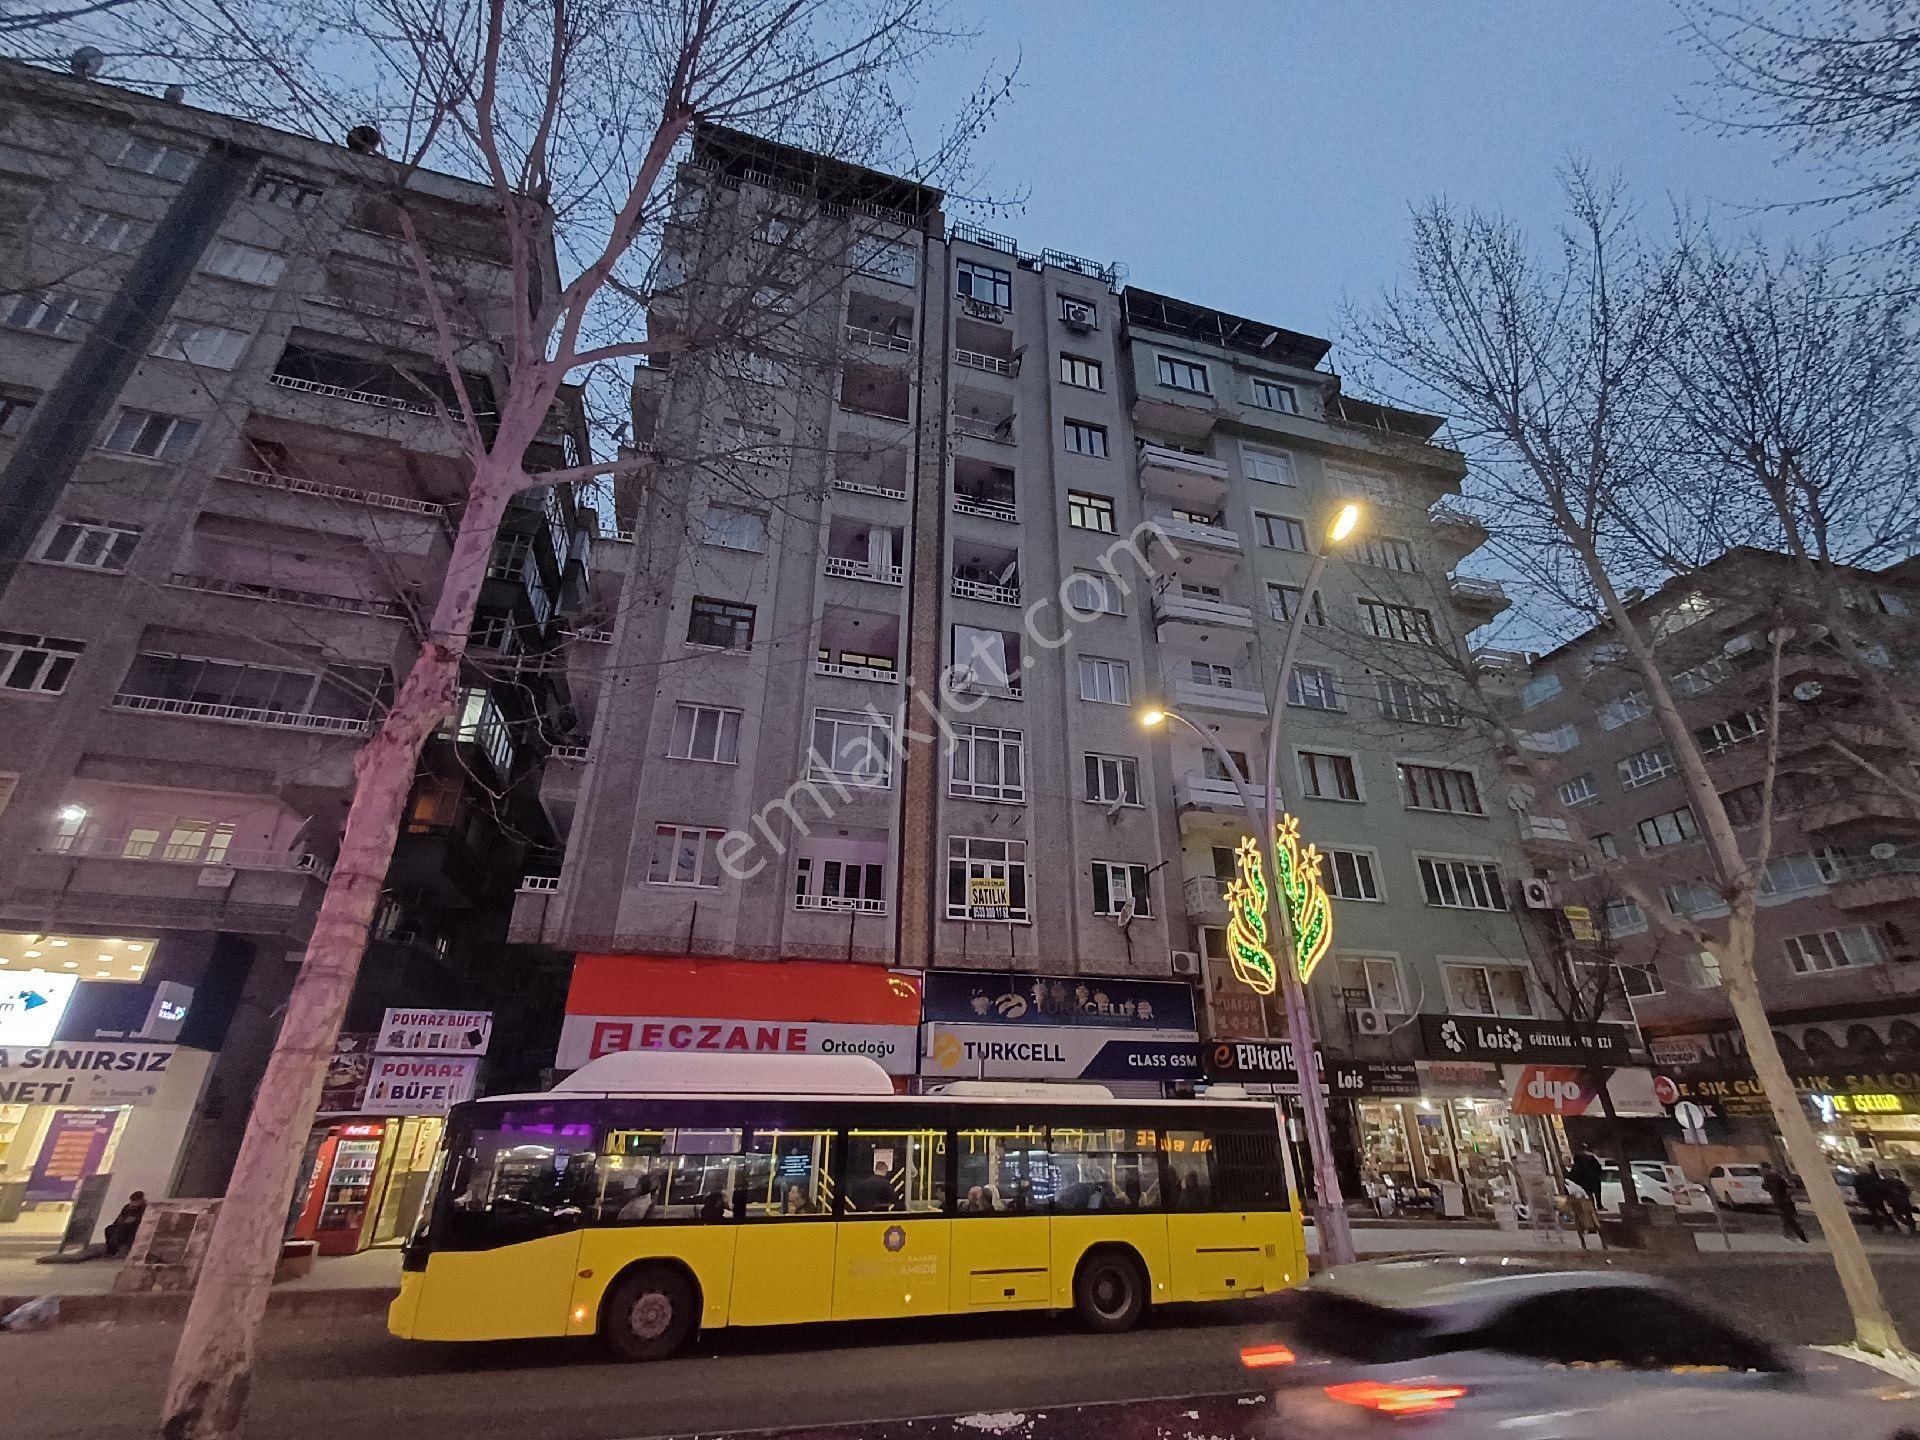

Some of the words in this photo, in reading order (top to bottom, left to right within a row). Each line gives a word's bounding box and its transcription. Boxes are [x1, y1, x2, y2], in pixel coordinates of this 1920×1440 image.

[392, 1013, 444, 1026] POYRAZ
[448, 1012, 482, 1027] BÜFE
[640, 1024, 807, 1051] ECZANE
[821, 1037, 895, 1058] Ortadoğu
[1477, 1025, 1511, 1049] Lois
[20, 1048, 172, 1072] SINIRSIZ
[964, 1041, 1065, 1062] TURKCELL
[1128, 1054, 1167, 1067] CLASS
[1170, 1055, 1197, 1067] GSM
[381, 1063, 465, 1077] POYRAZ
[1338, 1069, 1364, 1089] Lois
[391, 1082, 445, 1099] BÜFE
[1527, 1071, 1580, 1109] dyo
